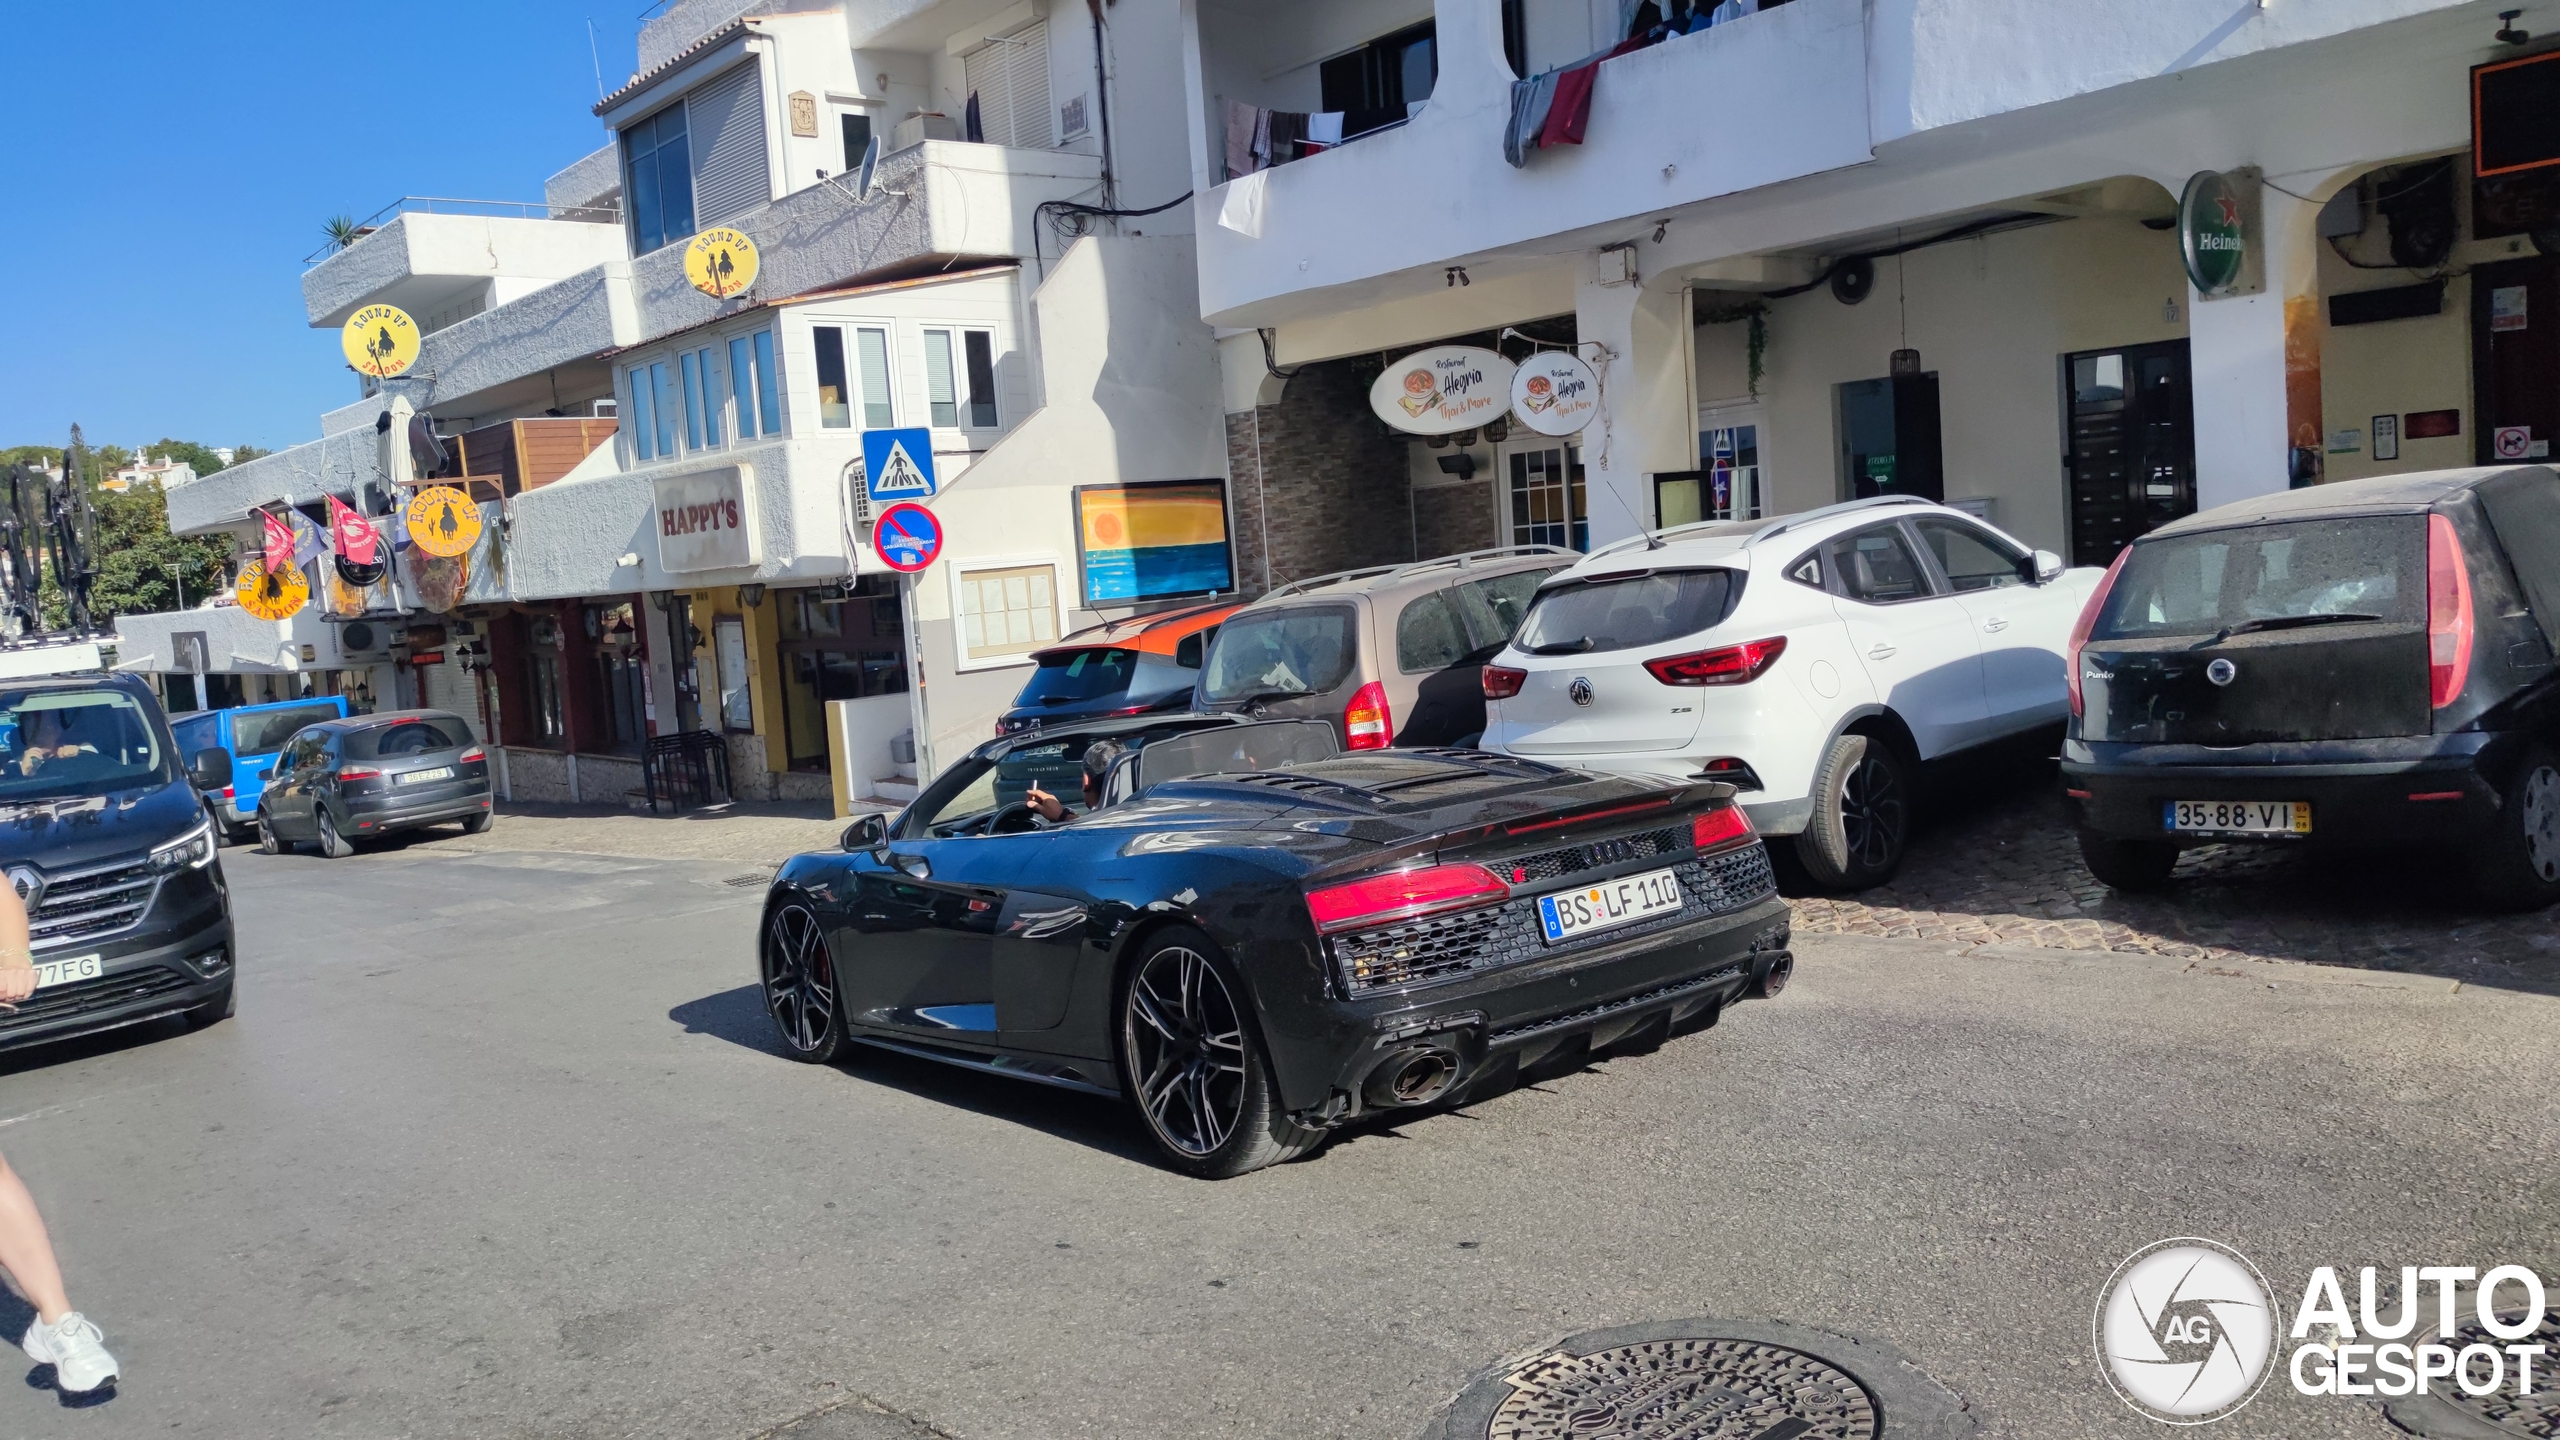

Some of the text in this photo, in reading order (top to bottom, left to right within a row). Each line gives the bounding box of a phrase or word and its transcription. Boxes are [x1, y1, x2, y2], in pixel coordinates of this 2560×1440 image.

[695, 231, 748, 252] ROUND UP
[353, 307, 407, 329] ROUND UP
[1435, 355, 1467, 370] Restaurant
[1551, 368, 1575, 378] Restaurant
[1443, 368, 1483, 397] Alegria
[1558, 378, 1586, 399] Alegria
[1437, 396, 1492, 421] Thai & More
[1553, 403, 1570, 418] Thai
[409, 488, 460, 524] ROUND
[462, 501, 480, 523] UP
[662, 498, 739, 536] HAPPY'S
[414, 531, 477, 555] SALOON
[239, 562, 287, 592] ROUD
[244, 594, 303, 620] SALOON
[2086, 670, 2115, 681] Punto
[1670, 706, 1693, 715] ZS
[1549, 874, 1678, 931] D BS LF 110
[1614, 1374, 1677, 1410] ALGARVE
